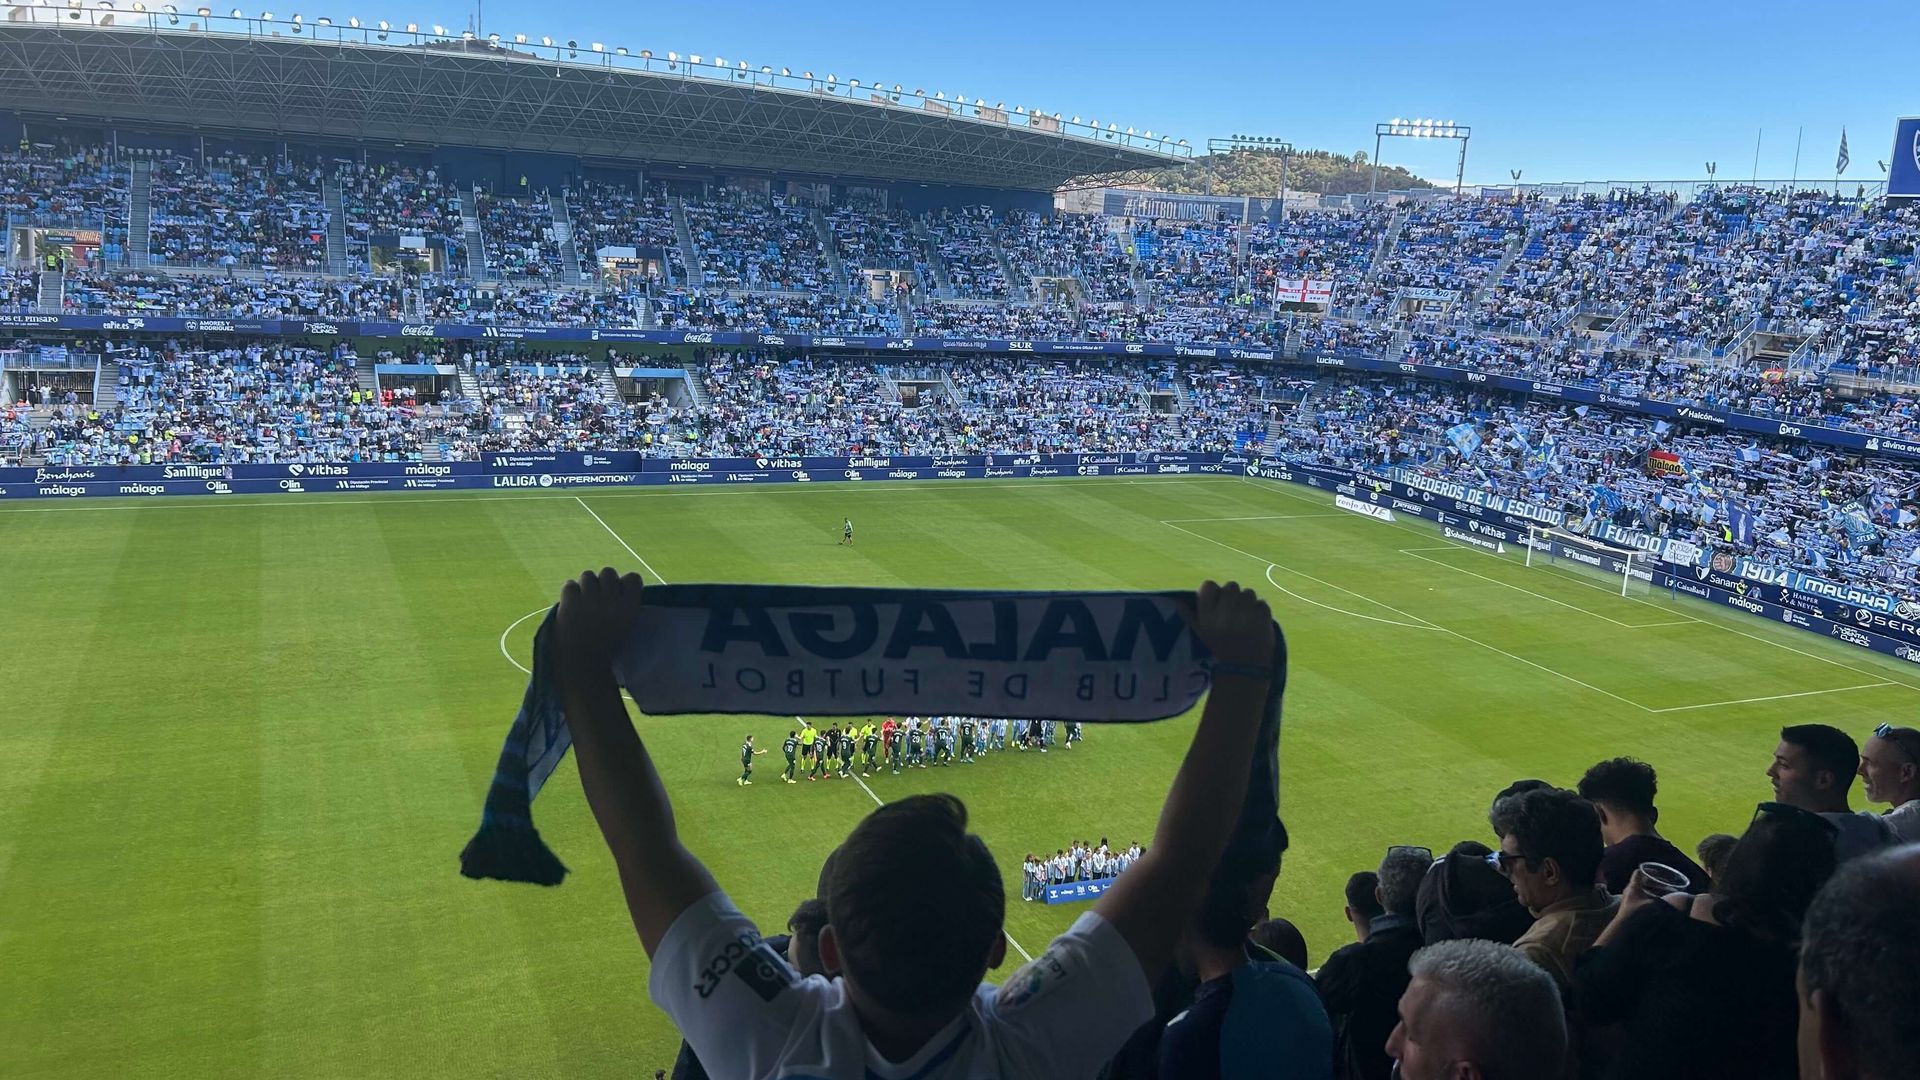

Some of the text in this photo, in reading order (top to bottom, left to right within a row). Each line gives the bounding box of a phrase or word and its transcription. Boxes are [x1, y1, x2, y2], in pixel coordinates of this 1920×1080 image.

[1184, 348, 1216, 357] hummel
[1241, 349, 1273, 360] hummel
[770, 459, 802, 468] vithas
[1089, 455, 1119, 464] CaixaBank
[307, 464, 349, 475] vithas
[1260, 468, 1293, 481] vithas
[206, 482, 228, 490] Olin
[280, 480, 300, 489] Olin
[494, 476, 537, 487] LALIGA
[1400, 470, 1464, 503] HEREDEROS
[1466, 488, 1484, 506] DE
[1506, 499, 1561, 526] ESCUDO
[1480, 523, 1506, 540] vithas
[1572, 549, 1601, 567] hummel
[1741, 560, 1789, 588] 1904
[1677, 581, 1706, 597] CaixaBank
[1793, 592, 1819, 605] HARPER
